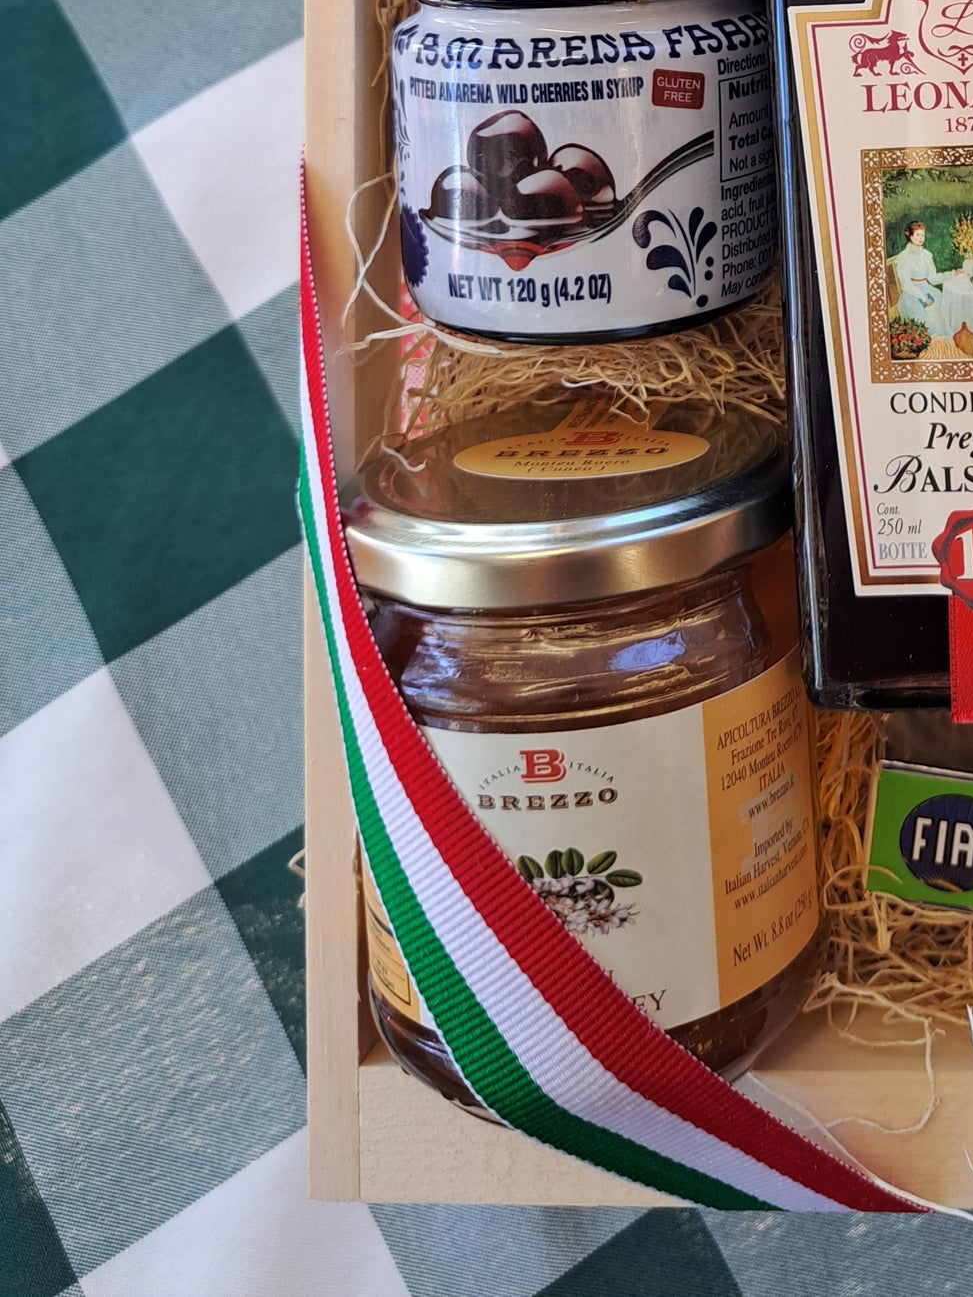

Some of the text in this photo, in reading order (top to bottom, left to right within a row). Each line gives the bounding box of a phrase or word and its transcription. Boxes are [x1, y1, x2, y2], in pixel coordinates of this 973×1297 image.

[414, 31, 657, 71] AMARENA
[410, 76, 437, 101] PITTED
[497, 83, 529, 104] WILD
[531, 79, 590, 104] CHERRIES
[592, 78, 604, 100] IN
[656, 75, 701, 91] GLUTEN
[663, 90, 693, 103] FREE
[728, 129, 760, 151] Total
[729, 158, 749, 173] Not
[722, 257, 757, 280] Phone:
[447, 272, 613, 307] NET WT 120 g (4.2 OZ)
[720, 280, 744, 299] May
[493, 446, 670, 458] BREZZO
[876, 502, 901, 516] Cont.
[877, 517, 922, 536] 250 ml
[878, 542, 928, 561] BOTTE
[717, 711, 771, 751] APICOLTURA
[730, 738, 765, 766] Frazione
[478, 764, 521, 791] ITALIA
[518, 748, 567, 784] B
[569, 760, 614, 783] ITALIA
[720, 765, 747, 791] 12040
[758, 762, 786, 792] ITALIA
[477, 787, 618, 811] BREZZO
[724, 870, 752, 895] Italian
[732, 940, 752, 967] Net
[752, 928, 770, 954] Wt.
[771, 915, 785, 941] 8.8
